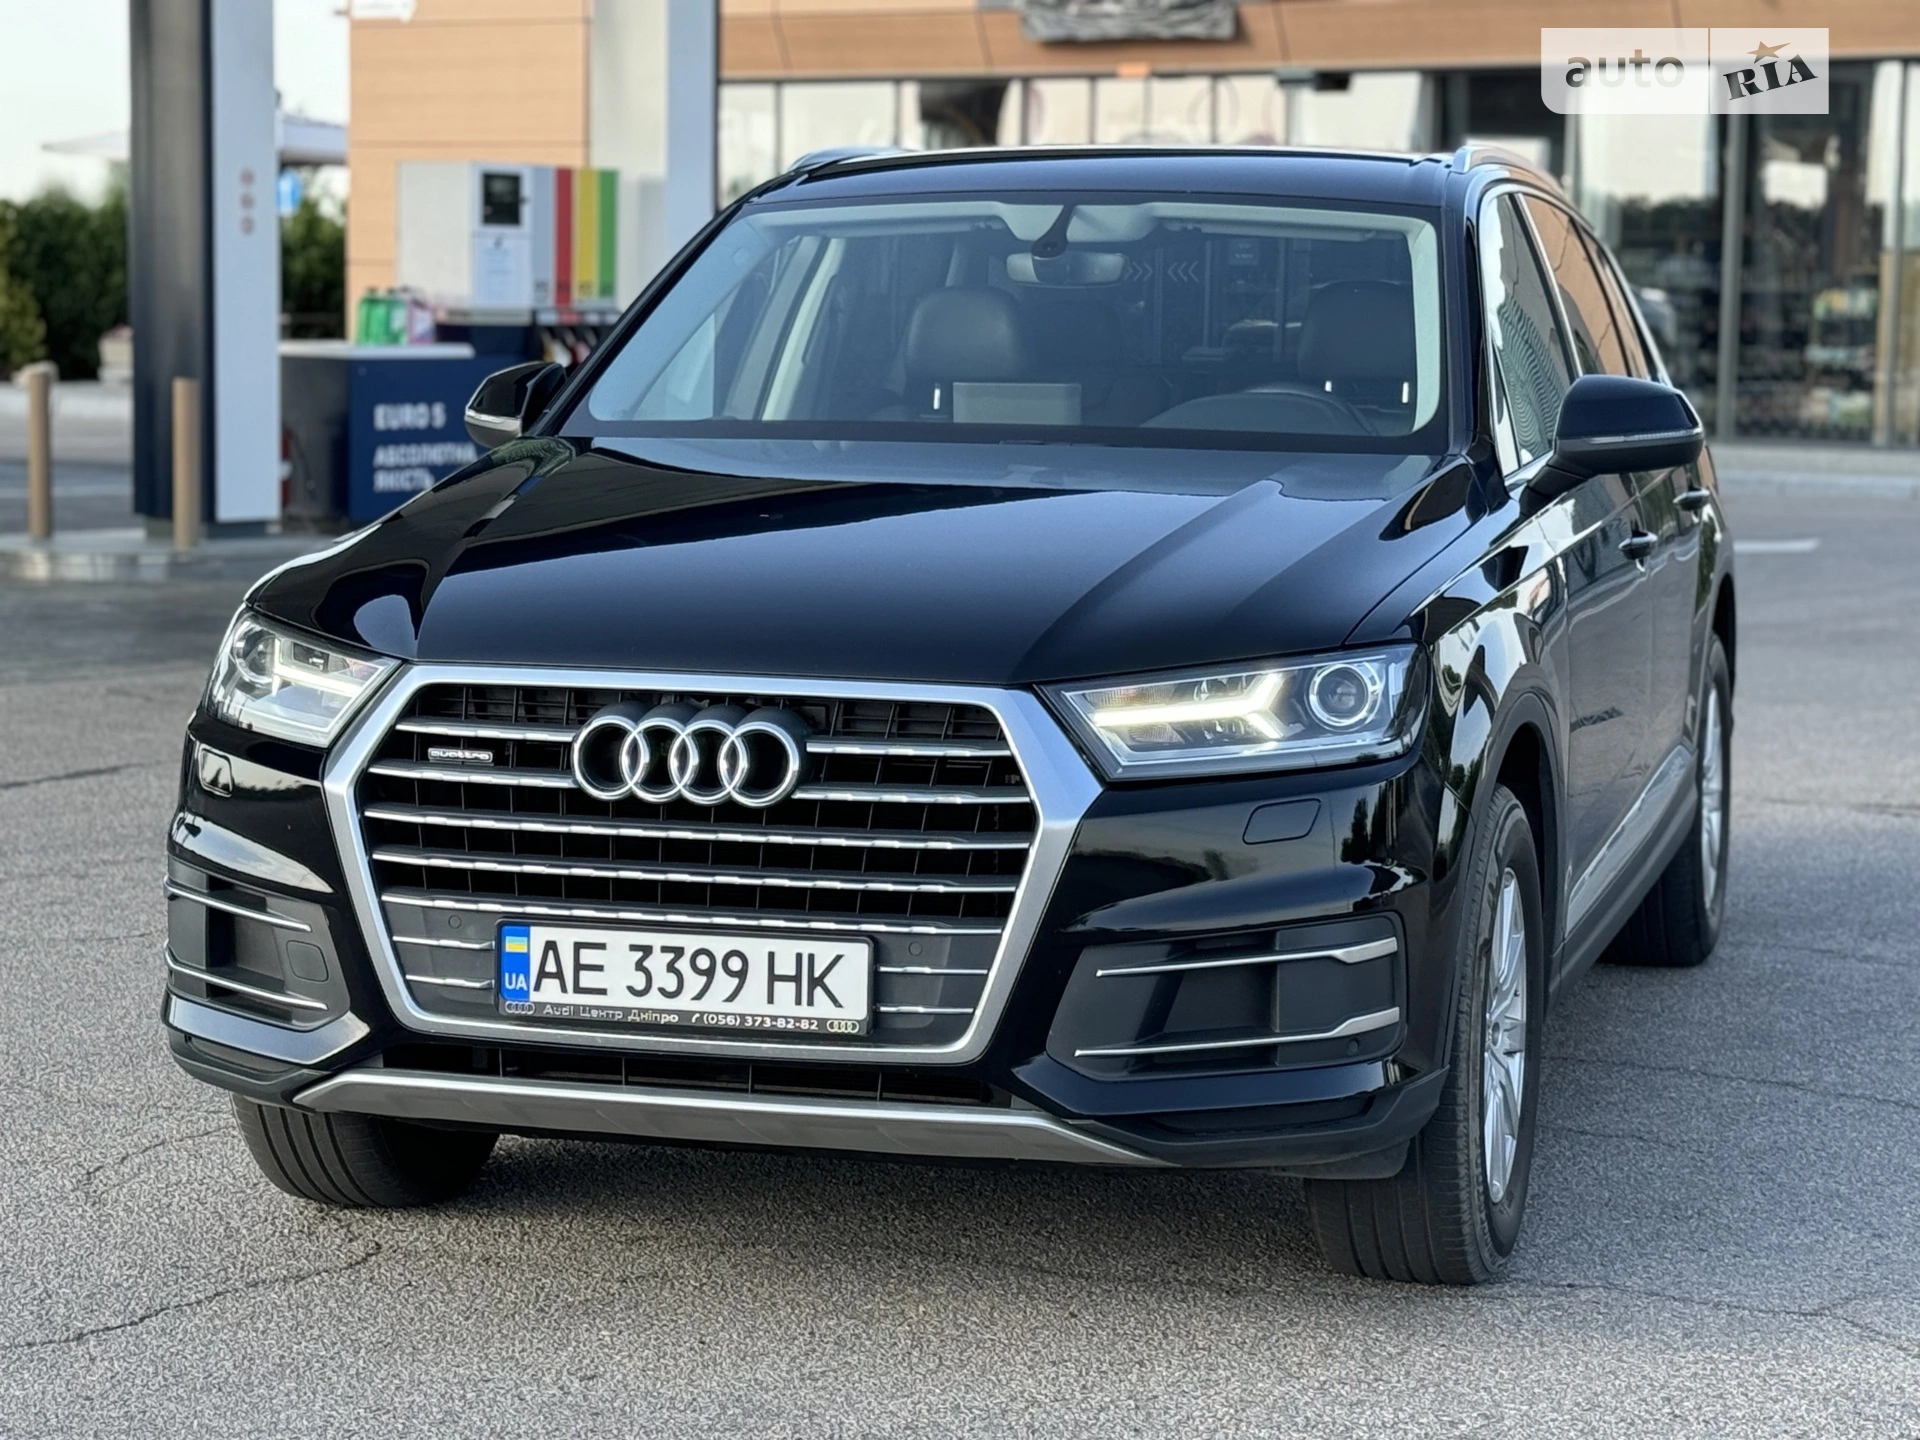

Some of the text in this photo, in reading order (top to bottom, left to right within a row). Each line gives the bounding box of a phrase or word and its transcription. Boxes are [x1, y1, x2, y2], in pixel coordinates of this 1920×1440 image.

[373, 402, 446, 430] EURO 5
[504, 972, 528, 991] UA
[533, 940, 845, 1008] AE 3399 HK
[543, 1004, 819, 1030] Audi Центр Дніпро (056) 373-82-82
